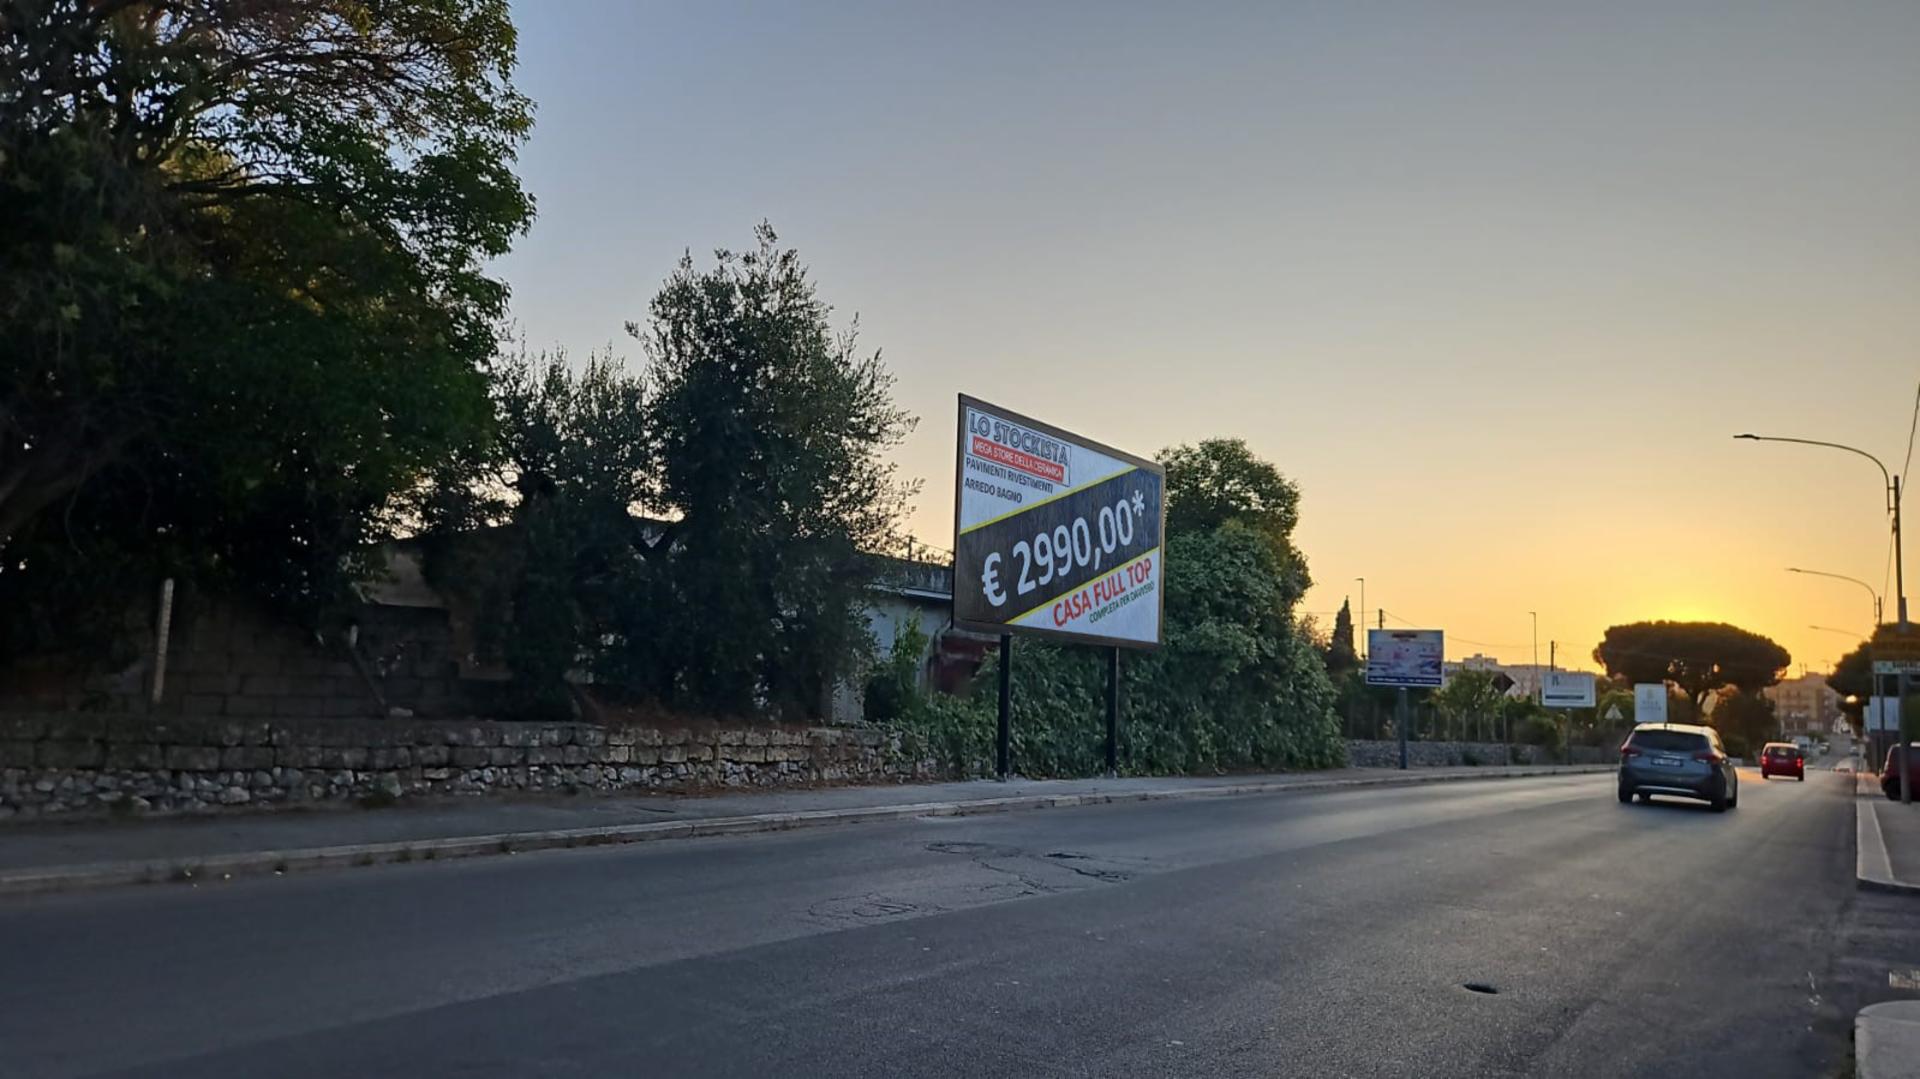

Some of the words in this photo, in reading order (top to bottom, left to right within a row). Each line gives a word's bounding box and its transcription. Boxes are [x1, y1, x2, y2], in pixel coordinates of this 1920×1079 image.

[969, 413, 990, 437] LO
[993, 421, 1068, 466] STOCKISTA
[974, 440, 993, 456] MEGA
[993, 447, 1014, 463] STORE
[965, 477, 996, 496] ARREDO
[997, 486, 1023, 503] BAGNO
[966, 457, 1006, 480] PAVIMENTI
[1008, 469, 1053, 494] RIVESTIMENTI
[981, 551, 1007, 607] €
[1053, 590, 1092, 627] CASA
[1093, 572, 1126, 607] FULL
[1126, 558, 1152, 587] TOP
[1089, 602, 1119, 624] COMPLETA
